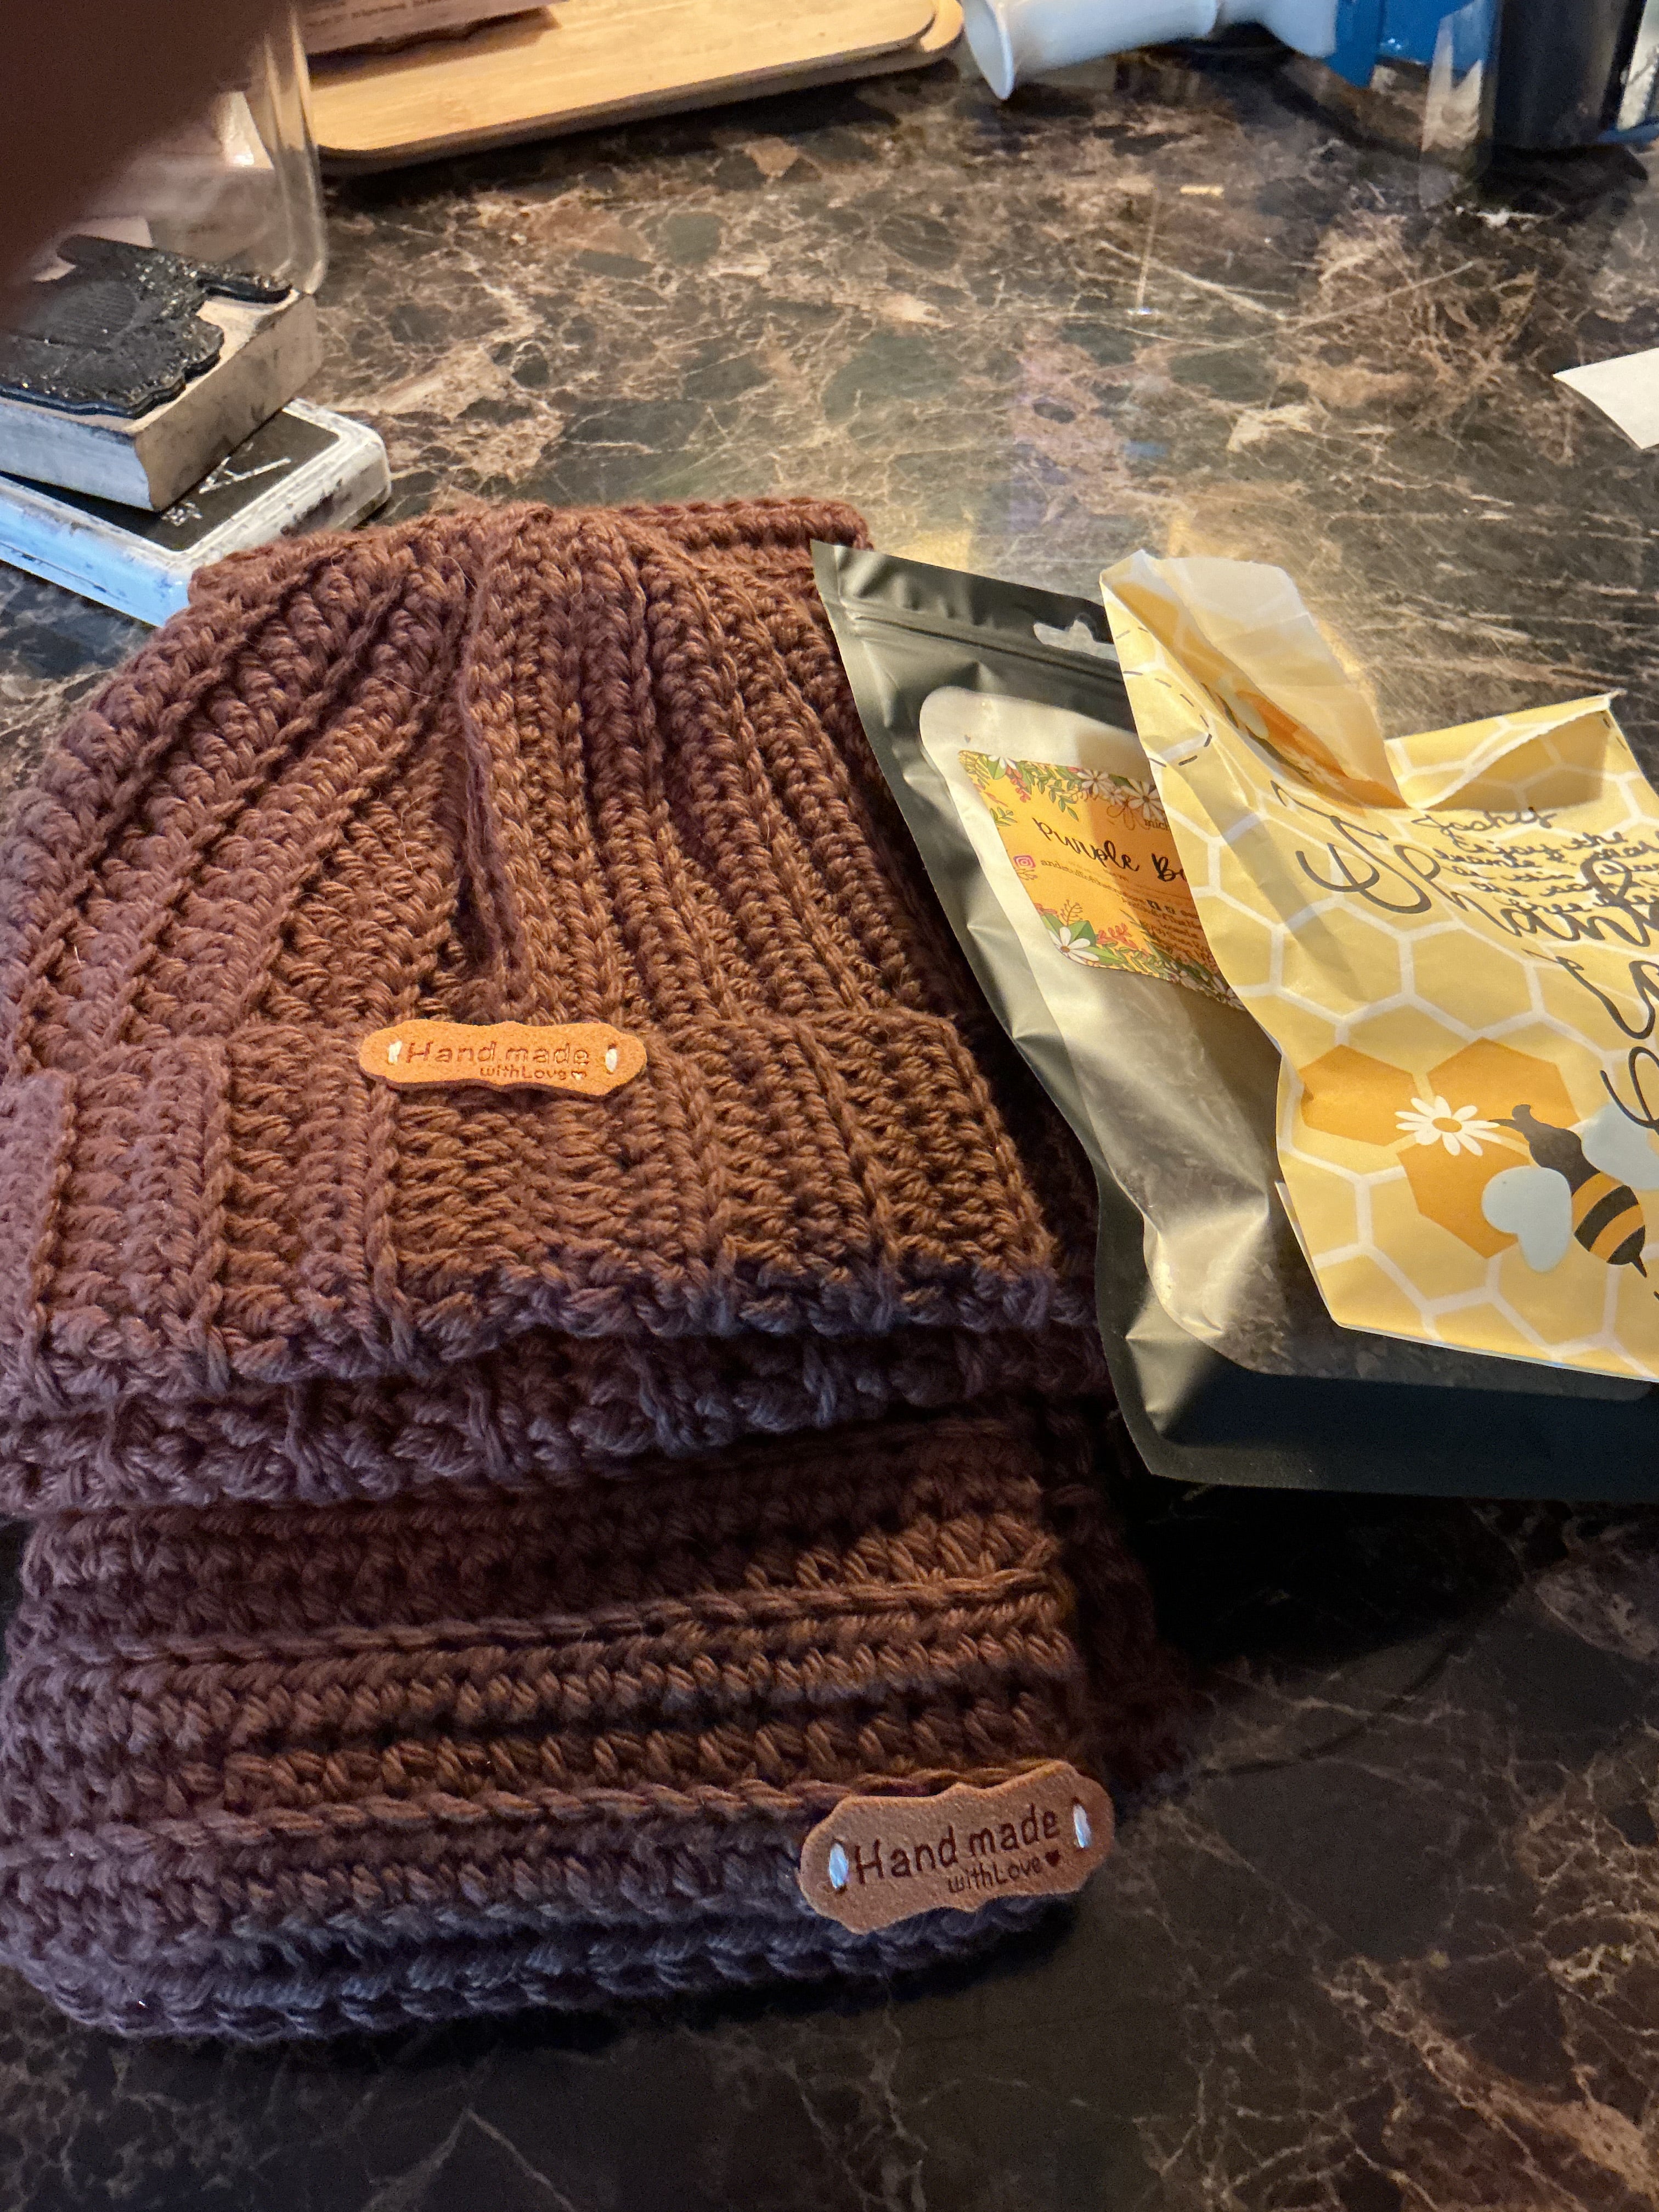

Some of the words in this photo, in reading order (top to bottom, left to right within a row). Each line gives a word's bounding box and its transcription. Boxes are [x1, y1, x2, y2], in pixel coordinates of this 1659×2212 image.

[1032, 817, 1139, 871] Purple
[405, 1041, 495, 1064] Hand
[505, 1042, 590, 1065] made
[854, 1825, 958, 1885] Hand
[969, 1803, 1060, 1857] made
